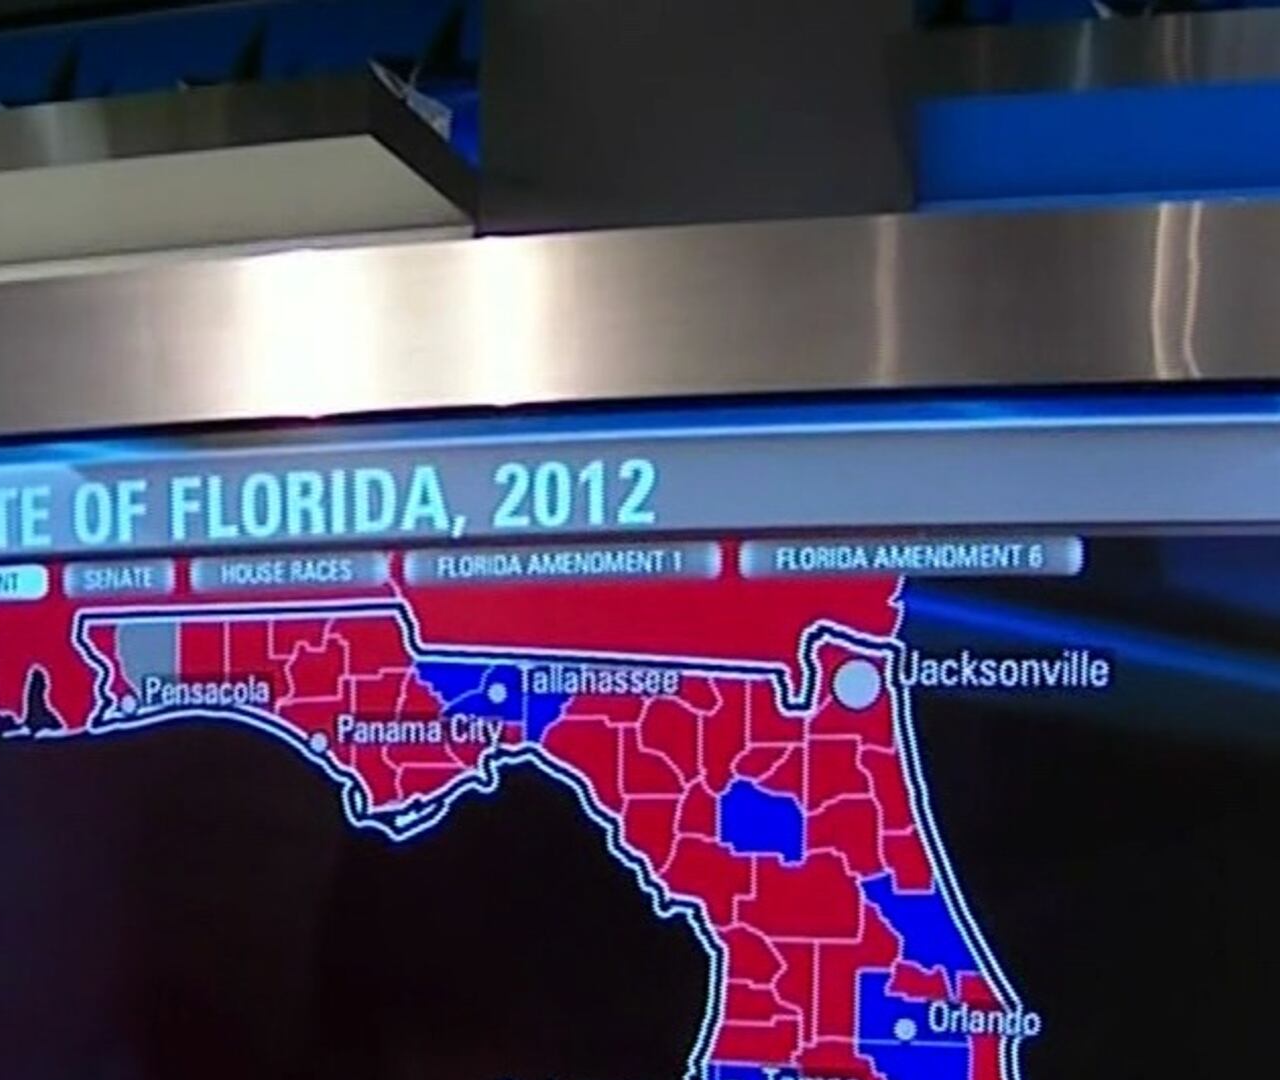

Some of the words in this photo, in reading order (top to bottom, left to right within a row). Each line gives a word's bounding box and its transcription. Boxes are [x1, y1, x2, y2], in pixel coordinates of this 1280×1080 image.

[73, 480, 149, 545] OF
[171, 464, 468, 540] FLORIDA,
[492, 458, 657, 529] 2012
[221, 563, 291, 586] HOUSE
[293, 559, 353, 584] RACES
[436, 554, 523, 579] FLORIDA
[525, 550, 665, 577] AMENDMENT
[668, 550, 682, 573] 1
[775, 546, 869, 571] FLORIDA
[872, 543, 1021, 570] AMENDMENT
[1028, 543, 1044, 567] 6
[82, 566, 154, 590] SENATE
[522, 664, 680, 697] Tallahassee
[898, 649, 1111, 690] Jacksonville
[145, 679, 272, 705] Pensacola
[336, 713, 444, 746] Panama
[449, 713, 504, 751] City
[928, 1002, 1042, 1038] Orlando
